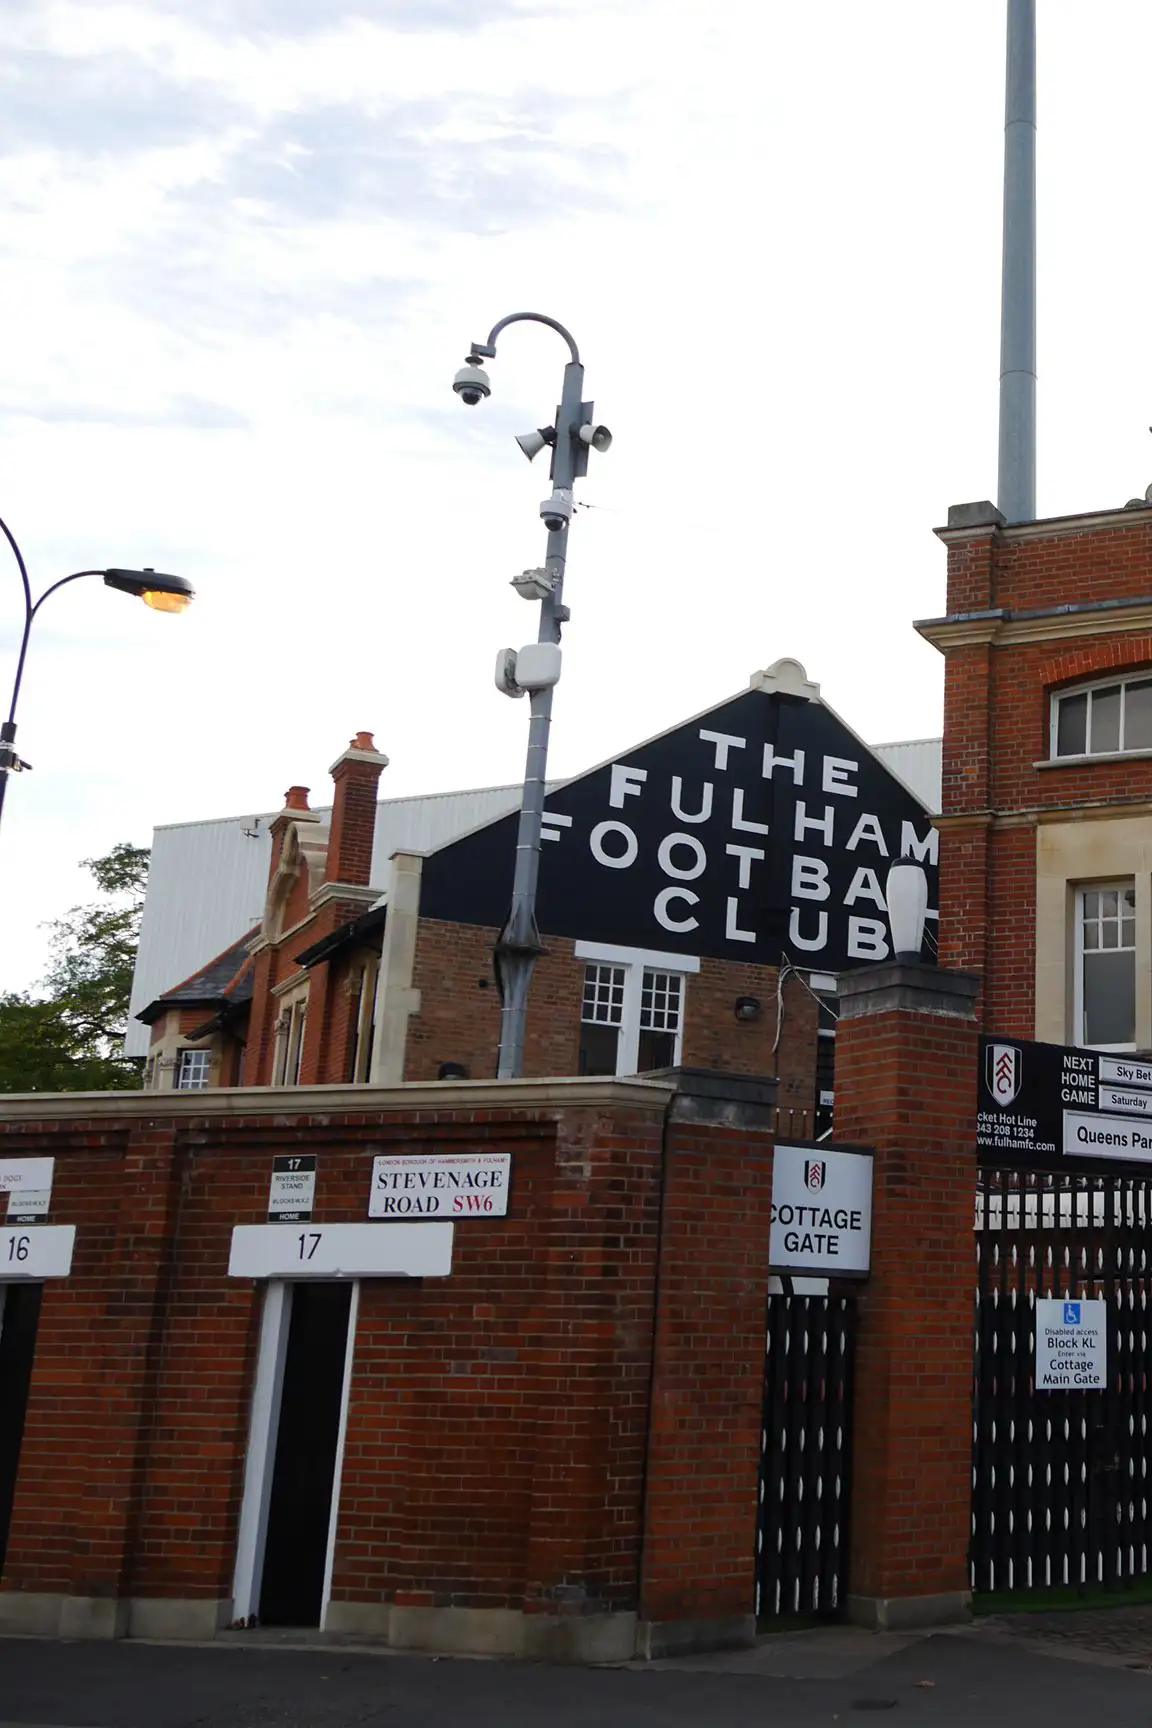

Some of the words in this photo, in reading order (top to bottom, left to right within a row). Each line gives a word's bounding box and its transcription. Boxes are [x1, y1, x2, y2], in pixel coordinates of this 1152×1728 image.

[700, 729, 859, 798] THE
[609, 764, 939, 866] FULHAM
[541, 811, 939, 920] FOOTBA
[653, 887, 890, 961] CLUB
[1063, 1055, 1094, 1071] NEXT
[1061, 1072, 1096, 1088] HOME
[1116, 1066, 1134, 1080] Sky
[1136, 1069, 1152, 1080] Bet
[1061, 1088, 1096, 1105] GAME
[1111, 1094, 1147, 1109] Saturday
[977, 1111, 998, 1123] cket
[999, 1113, 1016, 1125] Hot
[1017, 1115, 1037, 1127] Line
[993, 1125, 1011, 1136] 208
[1013, 1127, 1035, 1138] 1234
[1077, 1125, 1128, 1148] Queens
[977, 1135, 1055, 1152] ww.fulhamfc.com
[288, 1159, 301, 1170] 17
[377, 1170, 503, 1189] STEVENAGE
[383, 1196, 440, 1213] ROAD
[452, 1194, 493, 1212] SW6
[9, 1236, 30, 1261] 16
[298, 1233, 322, 1260] 17
[784, 1232, 839, 1255] GATE
[1044, 1328, 1075, 1336] Disabled
[1047, 1337, 1079, 1349] Block
[1082, 1337, 1096, 1348] KL
[1050, 1359, 1094, 1372] Cottage
[1042, 1374, 1070, 1385] Main
[1073, 1373, 1100, 1385] Gate
